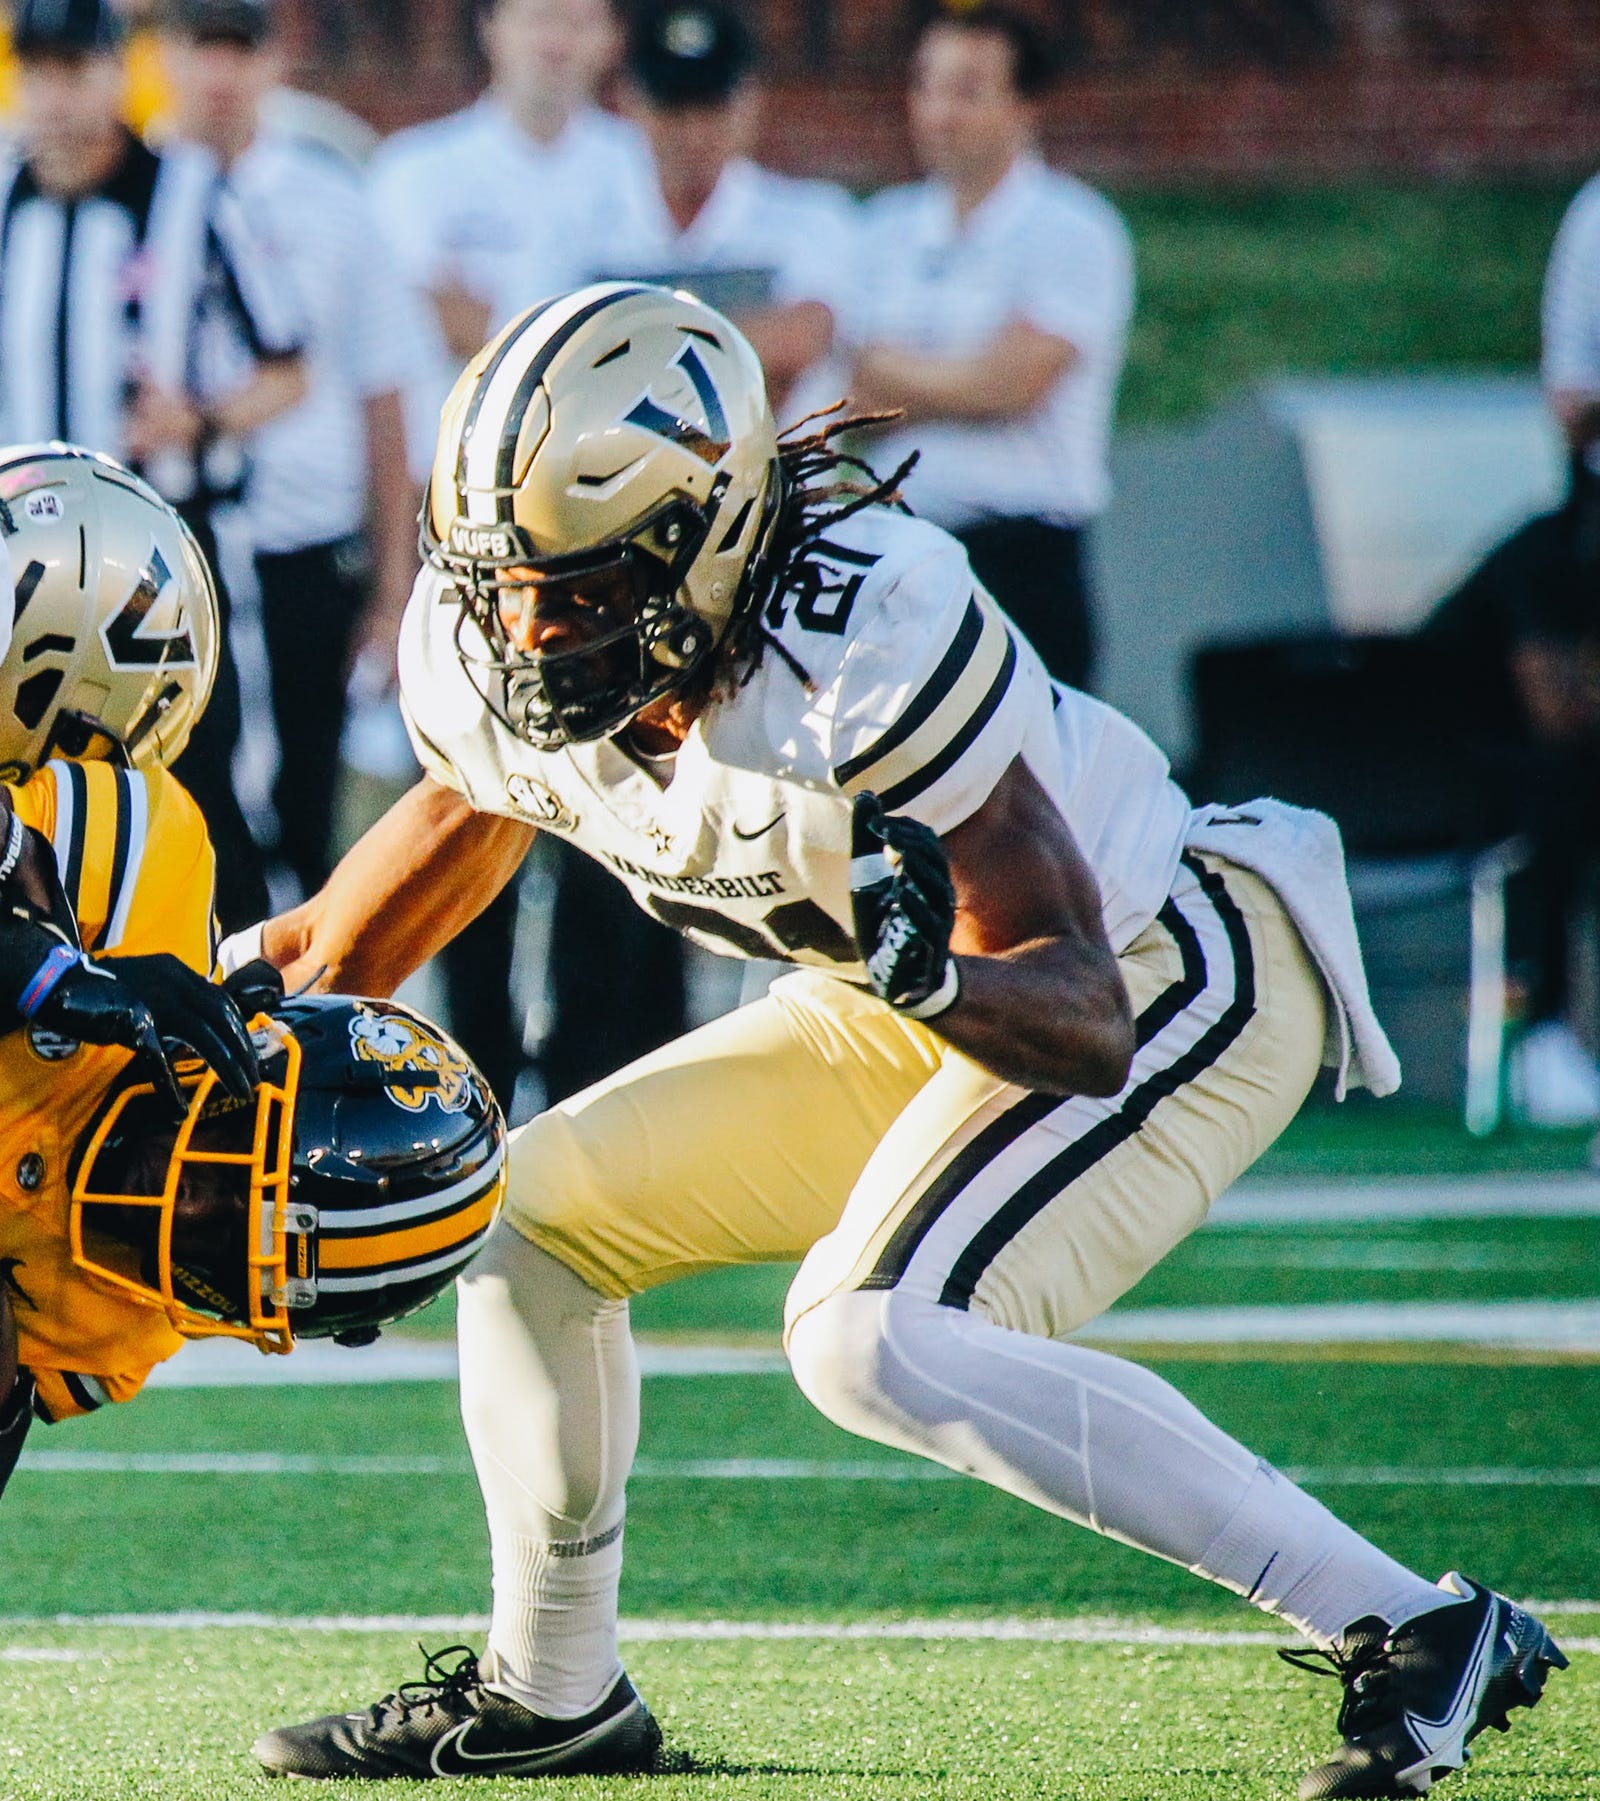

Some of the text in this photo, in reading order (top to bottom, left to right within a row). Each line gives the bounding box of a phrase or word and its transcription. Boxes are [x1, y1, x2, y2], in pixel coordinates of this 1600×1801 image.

[608, 333, 737, 476] V
[451, 526, 510, 558] VUFB
[602, 849, 787, 898] VANDERBILT
